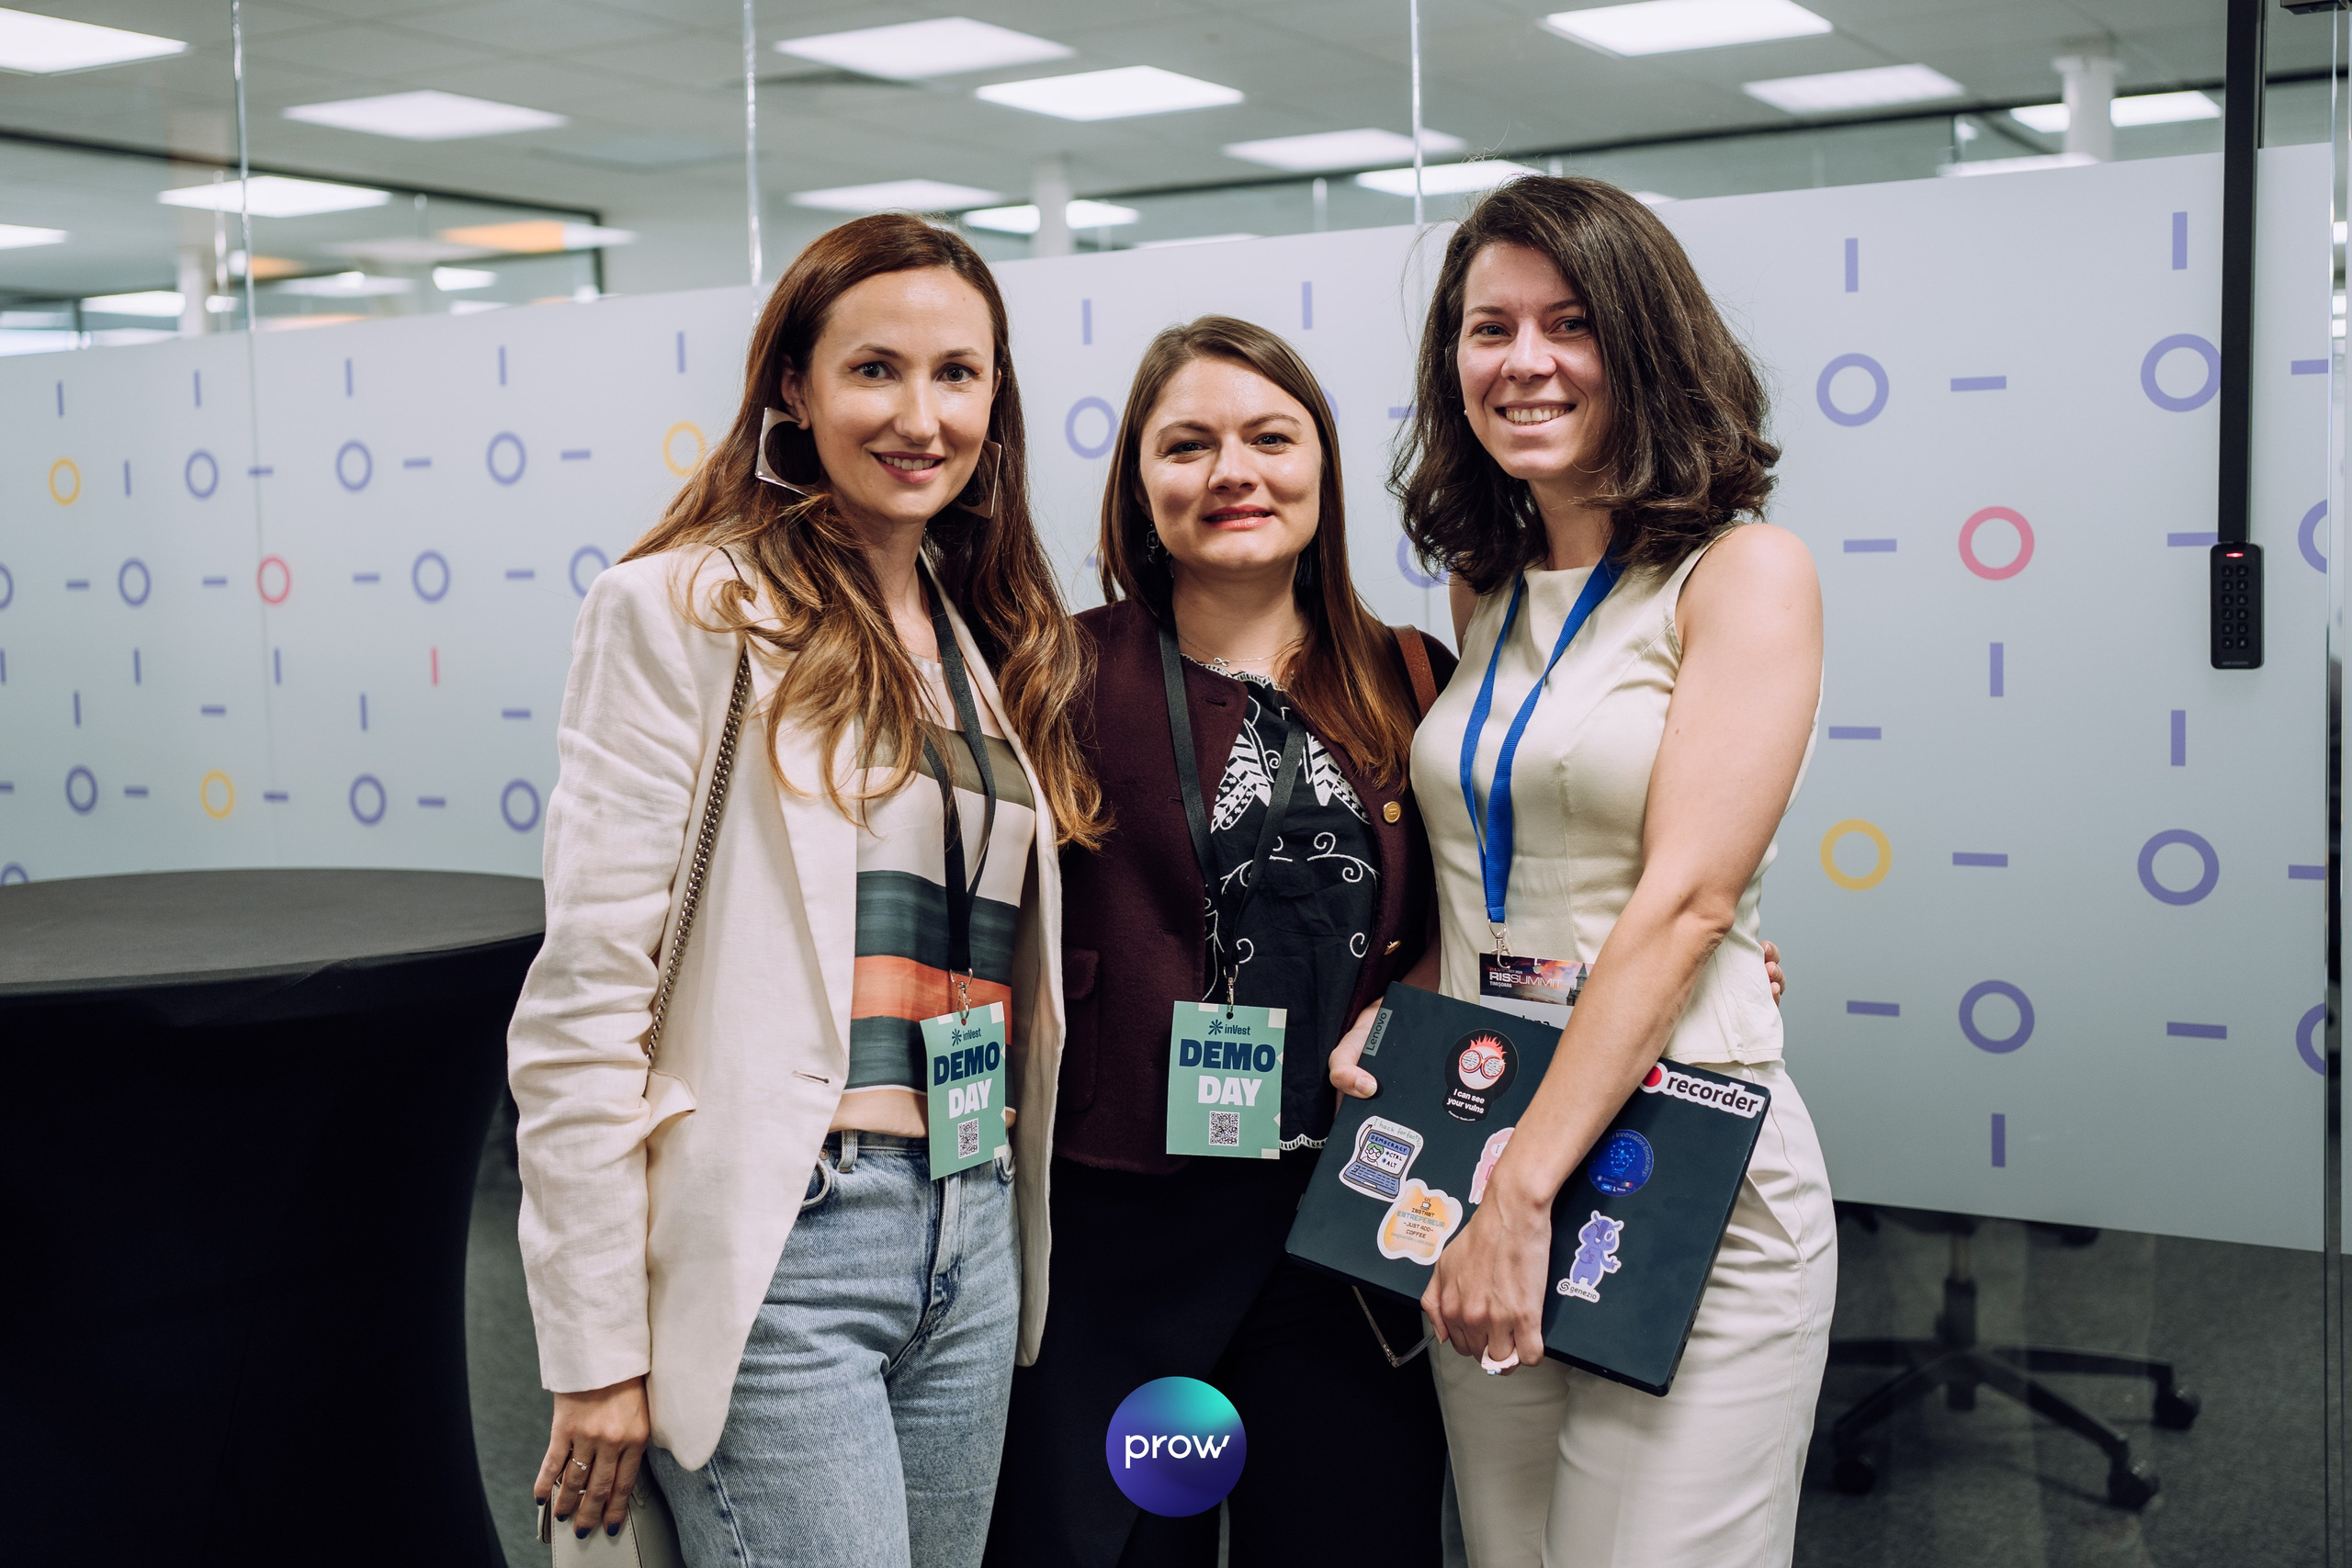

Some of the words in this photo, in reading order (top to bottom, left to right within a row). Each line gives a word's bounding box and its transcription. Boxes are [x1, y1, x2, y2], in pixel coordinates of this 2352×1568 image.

[1489, 972, 1563, 988] RISSUMMIT
[963, 1027, 981, 1042] inVest
[1224, 1024, 1251, 1035] inVest
[1366, 1012, 1387, 1051] Lenovo
[1180, 1038, 1276, 1073] DEMO
[933, 1041, 1001, 1087] DEMO
[1198, 1075, 1262, 1106] DAY
[1457, 1091, 1470, 1100] can
[1471, 1096, 1485, 1104] see
[1667, 1077, 1758, 1112] recorder
[948, 1078, 992, 1119] DAY
[1447, 1098, 1464, 1108] your
[1464, 1103, 1485, 1113] vulns
[1379, 1122, 1395, 1132] hack
[1371, 1135, 1407, 1152] DEMOCRACY
[1616, 1133, 1645, 1146] Innovation
[1389, 1152, 1402, 1161] CTRL
[1411, 1207, 1435, 1218] INSTANT
[1406, 1229, 1427, 1238] COFFEE
[1569, 1286, 1597, 1300] genezio
